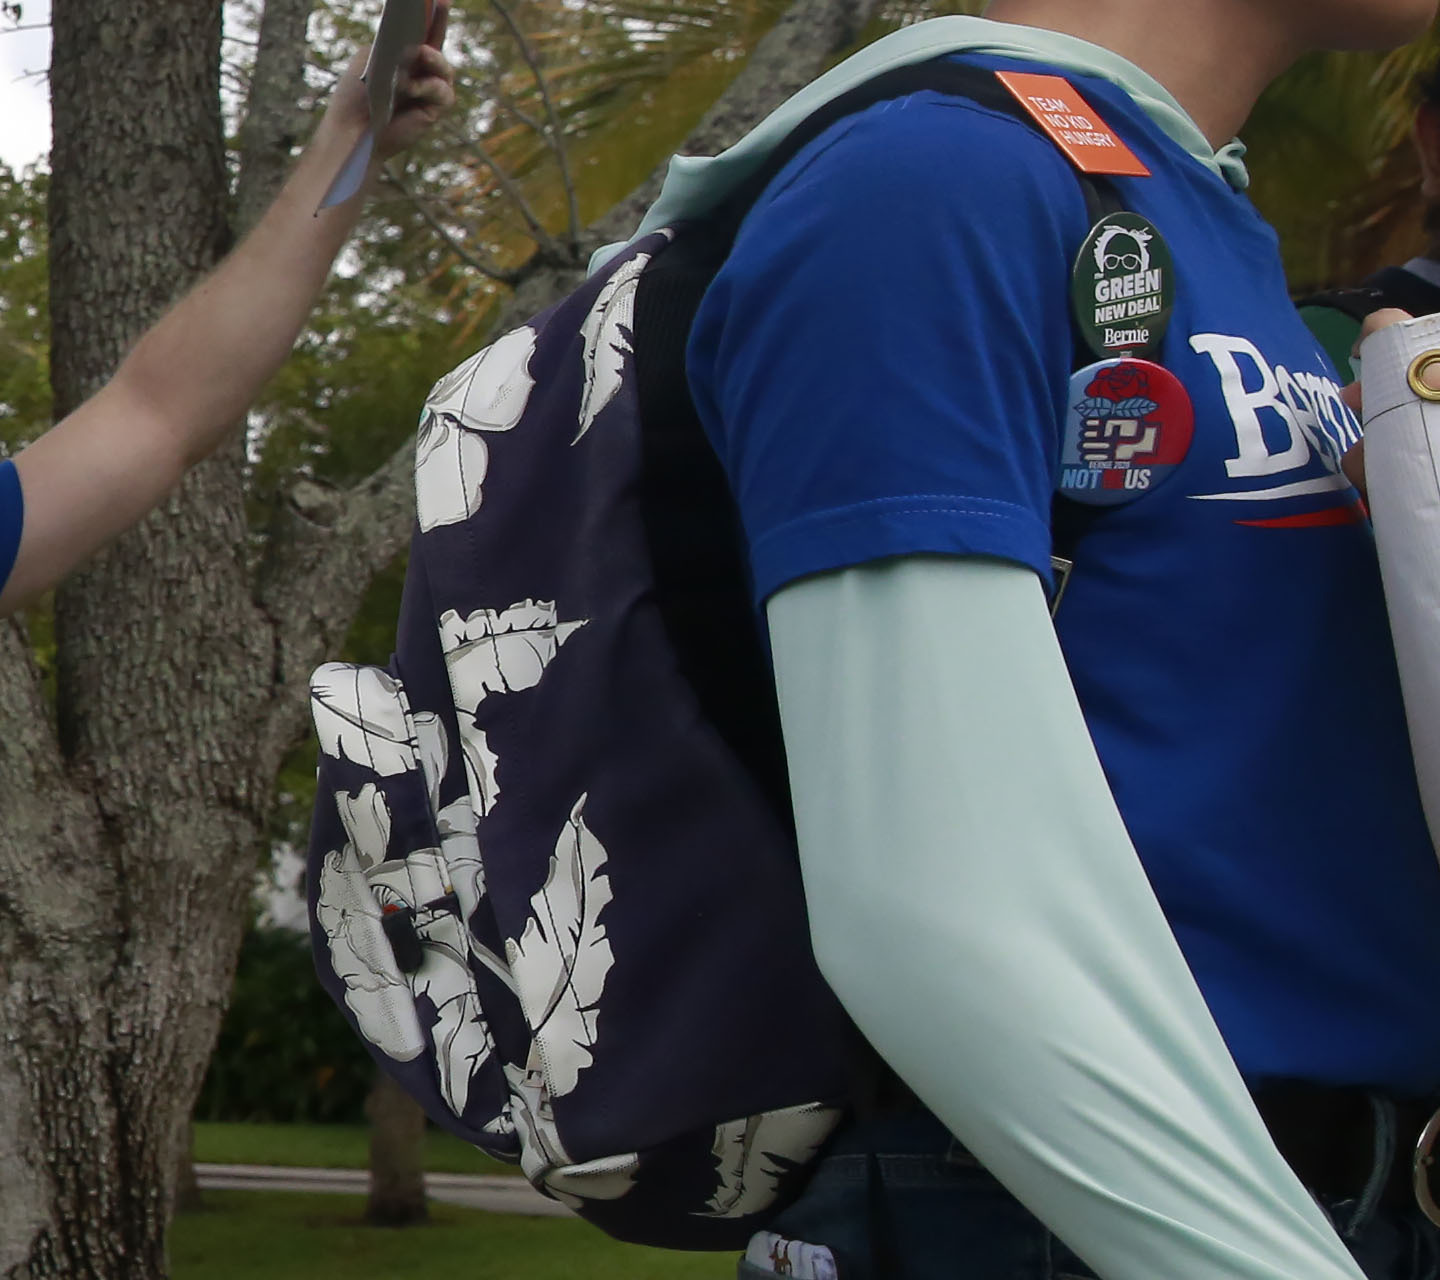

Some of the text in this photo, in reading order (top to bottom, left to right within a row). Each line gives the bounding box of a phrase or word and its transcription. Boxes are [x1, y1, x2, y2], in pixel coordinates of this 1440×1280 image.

[1027, 96, 1071, 113] TEAM
[1043, 113, 1094, 130] NO KID
[1059, 131, 1116, 147] HUNGRY
[1095, 269, 1160, 303] GREEN
[1095, 296, 1160, 324] NEW DEAL
[1104, 323, 1150, 344] Bernie
[1062, 469, 1151, 490] NOT US
